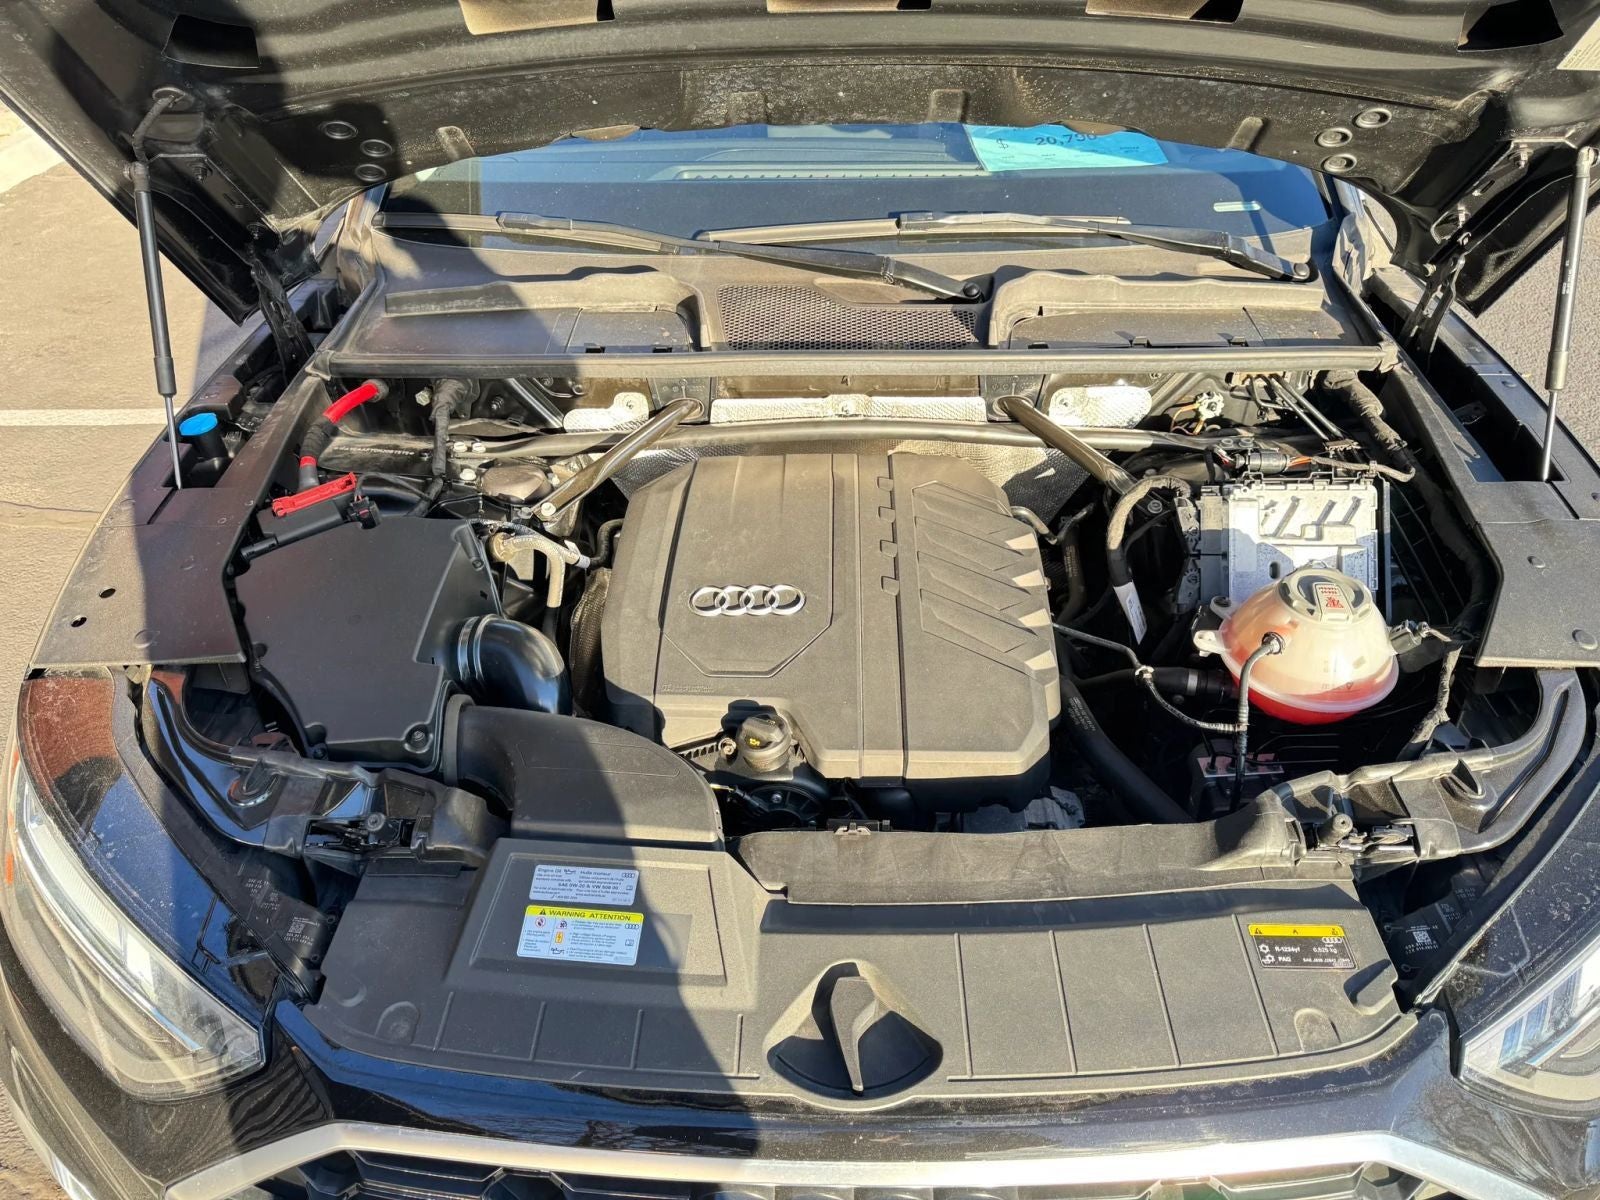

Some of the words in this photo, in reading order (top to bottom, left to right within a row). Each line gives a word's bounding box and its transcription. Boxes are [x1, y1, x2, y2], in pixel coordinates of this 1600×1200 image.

[996, 138, 1009, 150] $
[549, 910, 586, 918] WARNING
[589, 913, 631, 921] ATTENTION
